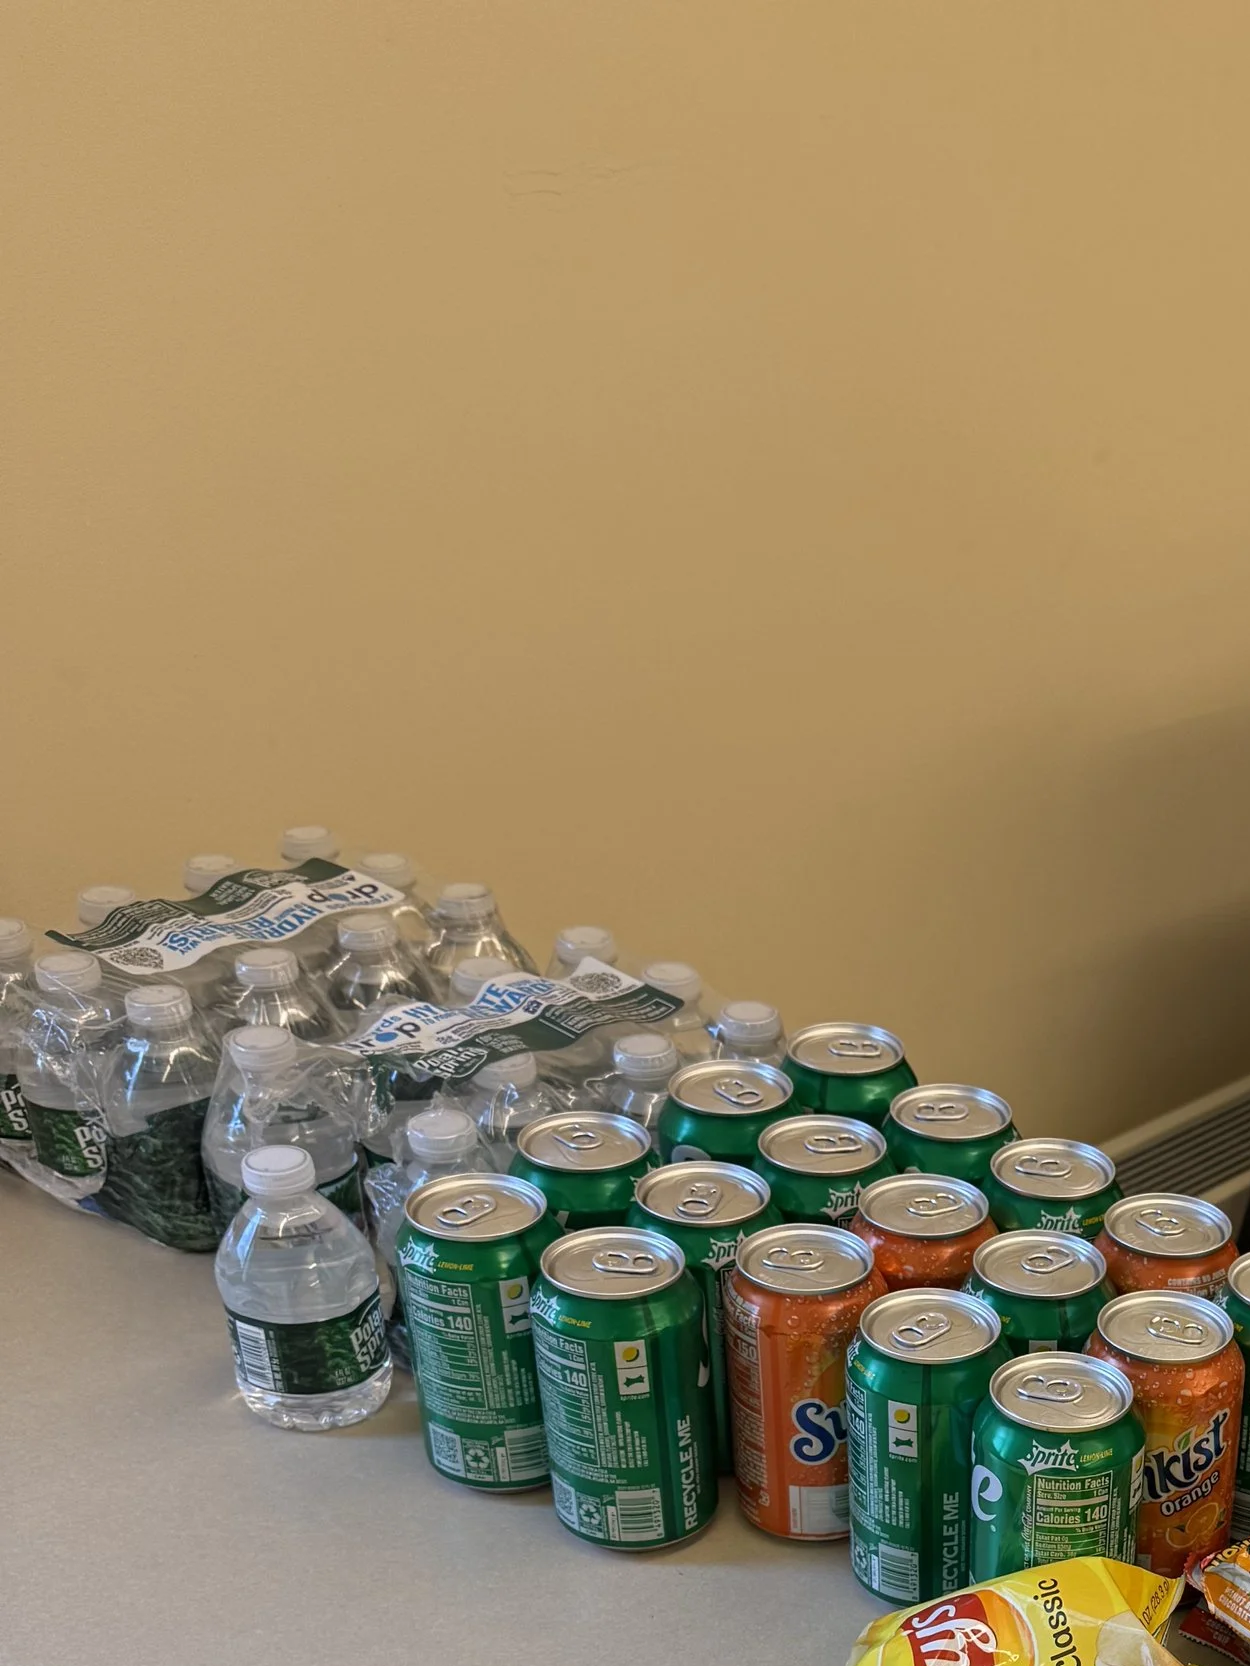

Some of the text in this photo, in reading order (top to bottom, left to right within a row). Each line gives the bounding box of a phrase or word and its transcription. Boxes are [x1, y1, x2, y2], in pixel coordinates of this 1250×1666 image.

[440, 1285, 468, 1298] Facts
[412, 1306, 473, 1331] Calories 140
[564, 1369, 588, 1386] 140
[1024, 1445, 1113, 1471] Sprite LEMON-LIME
[677, 1415, 698, 1531] RECYCLE ME
[1037, 1475, 1110, 1491] Nutrition Facts
[944, 1492, 959, 1518] ME
[1160, 1470, 1220, 1516] Orange
[1036, 1505, 1108, 1525] Calories 140
